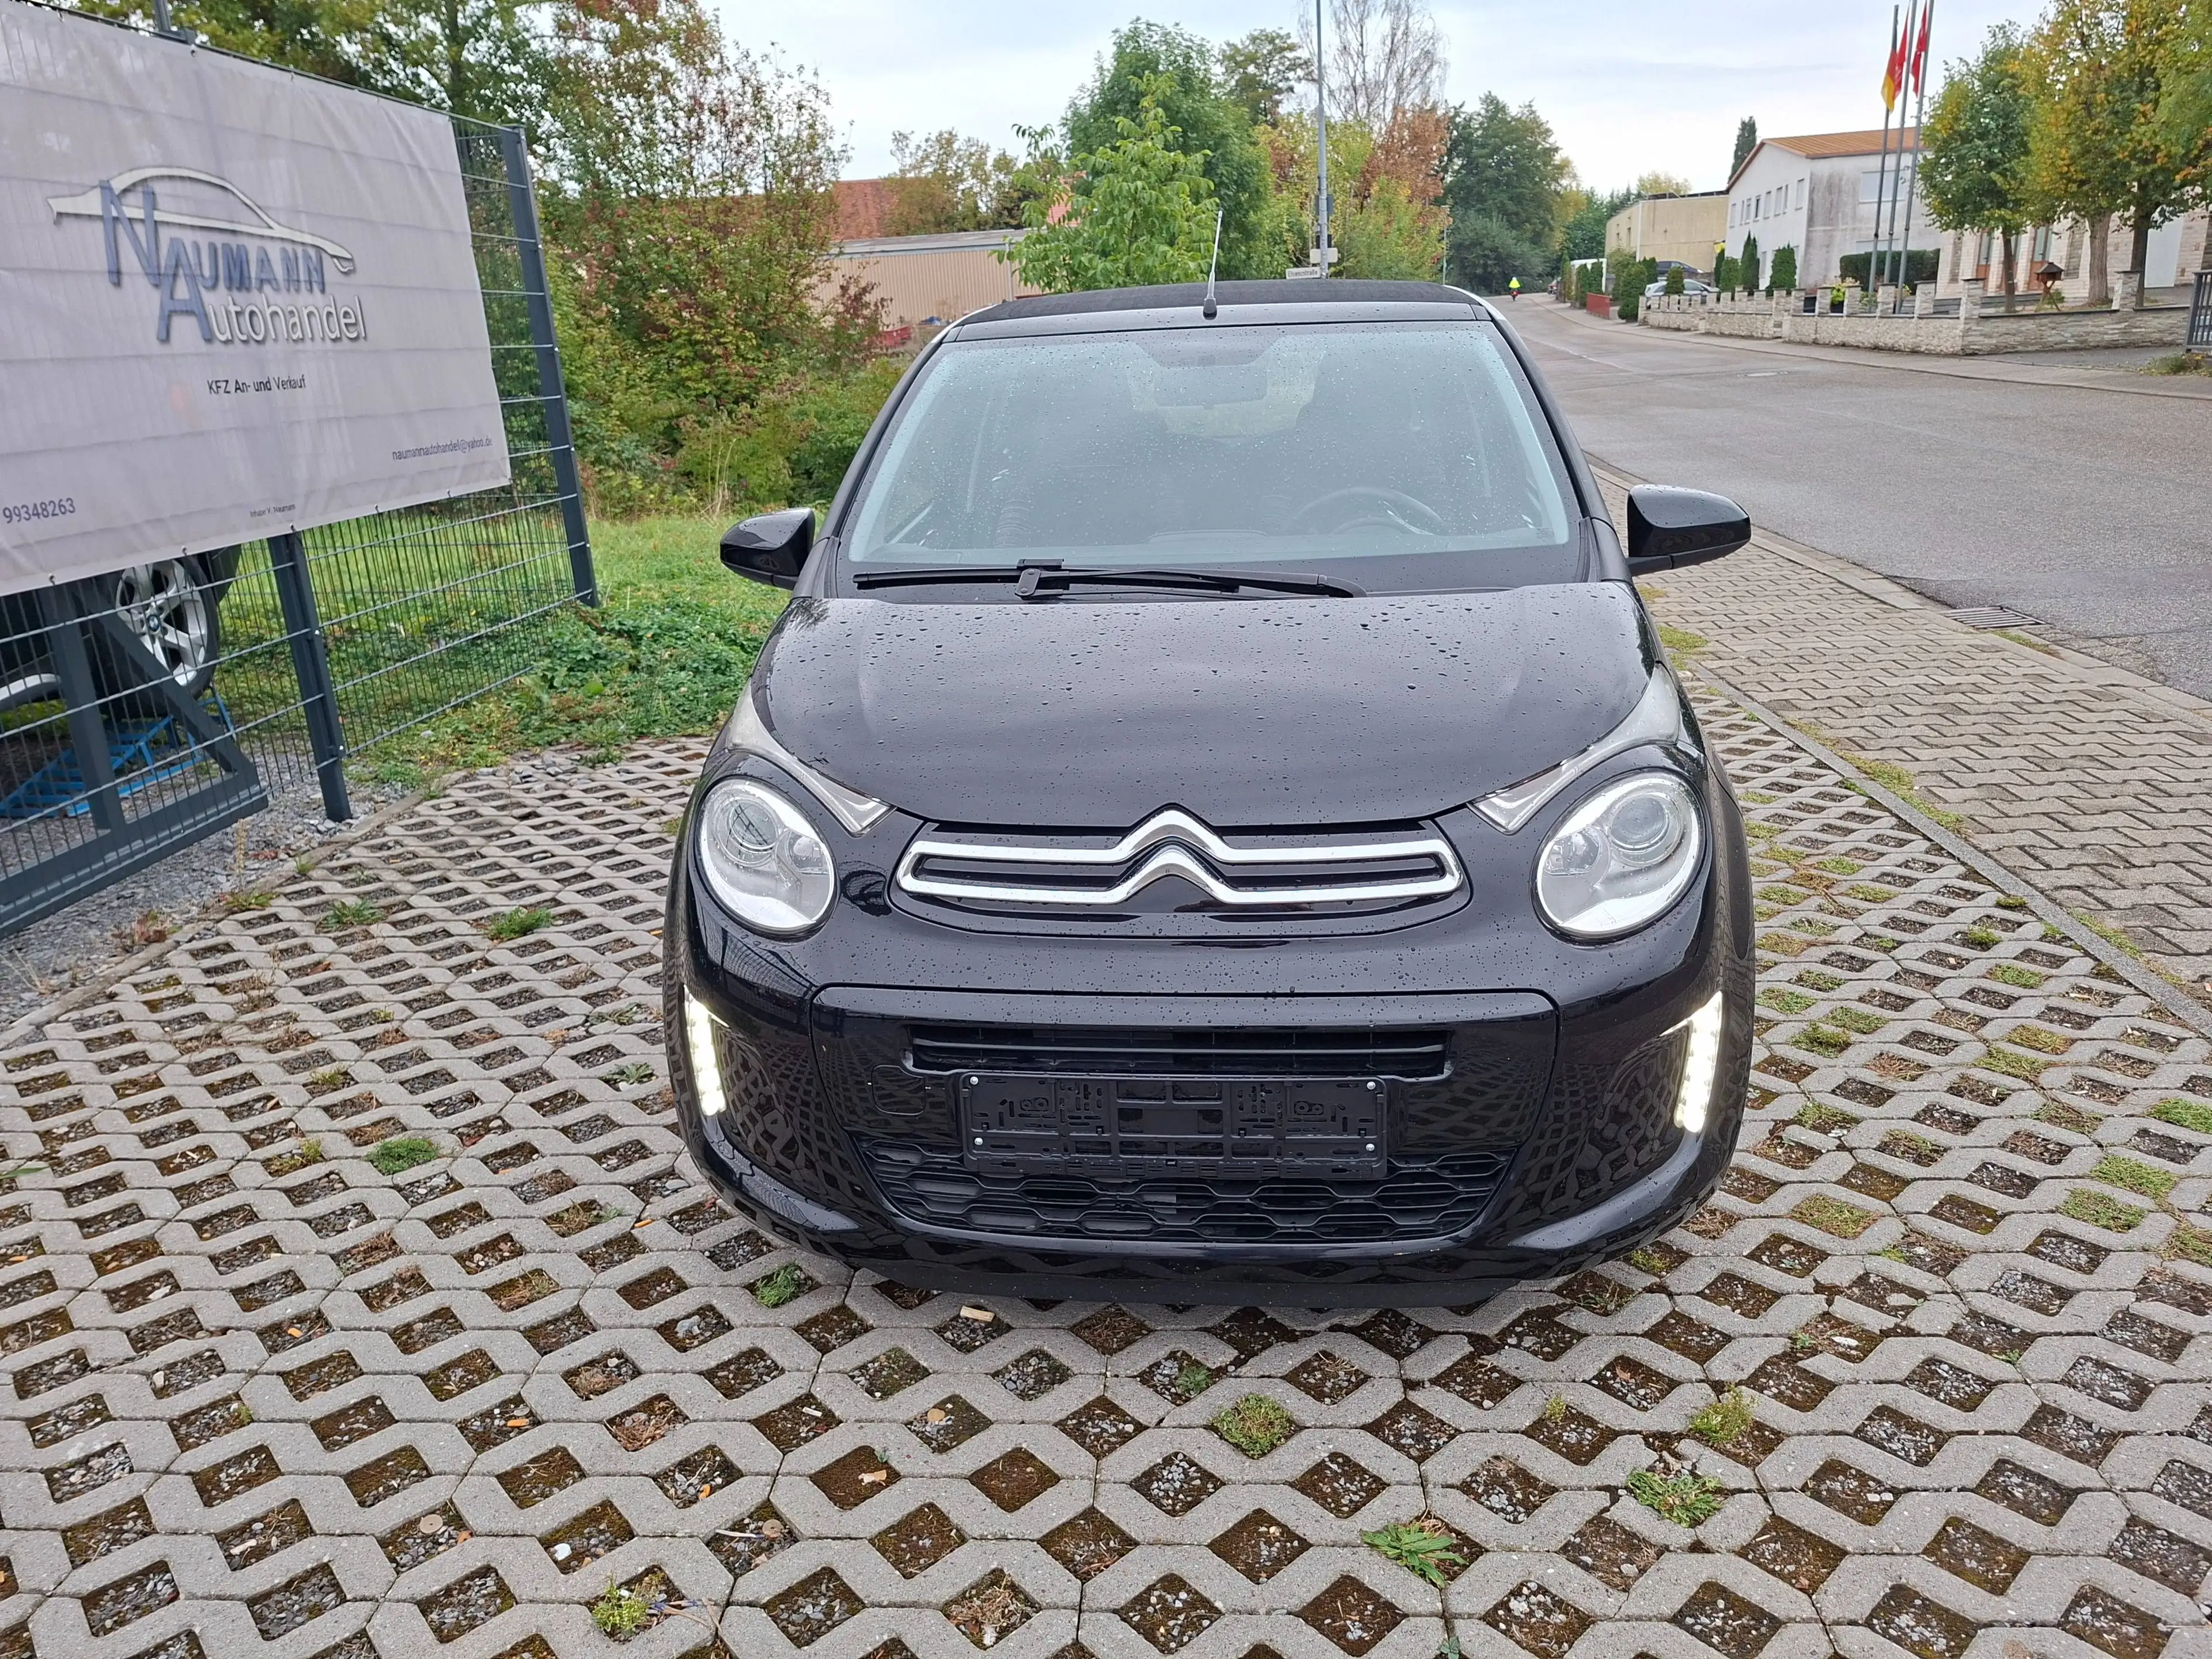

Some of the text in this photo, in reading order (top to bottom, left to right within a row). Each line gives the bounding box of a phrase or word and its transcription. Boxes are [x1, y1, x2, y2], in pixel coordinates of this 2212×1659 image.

[99, 180, 325, 294] NAUMANN
[157, 237, 366, 342] Autohandel
[207, 374, 306, 395] KFZ An- und Verkauf
[2, 497, 75, 524] 99348263
